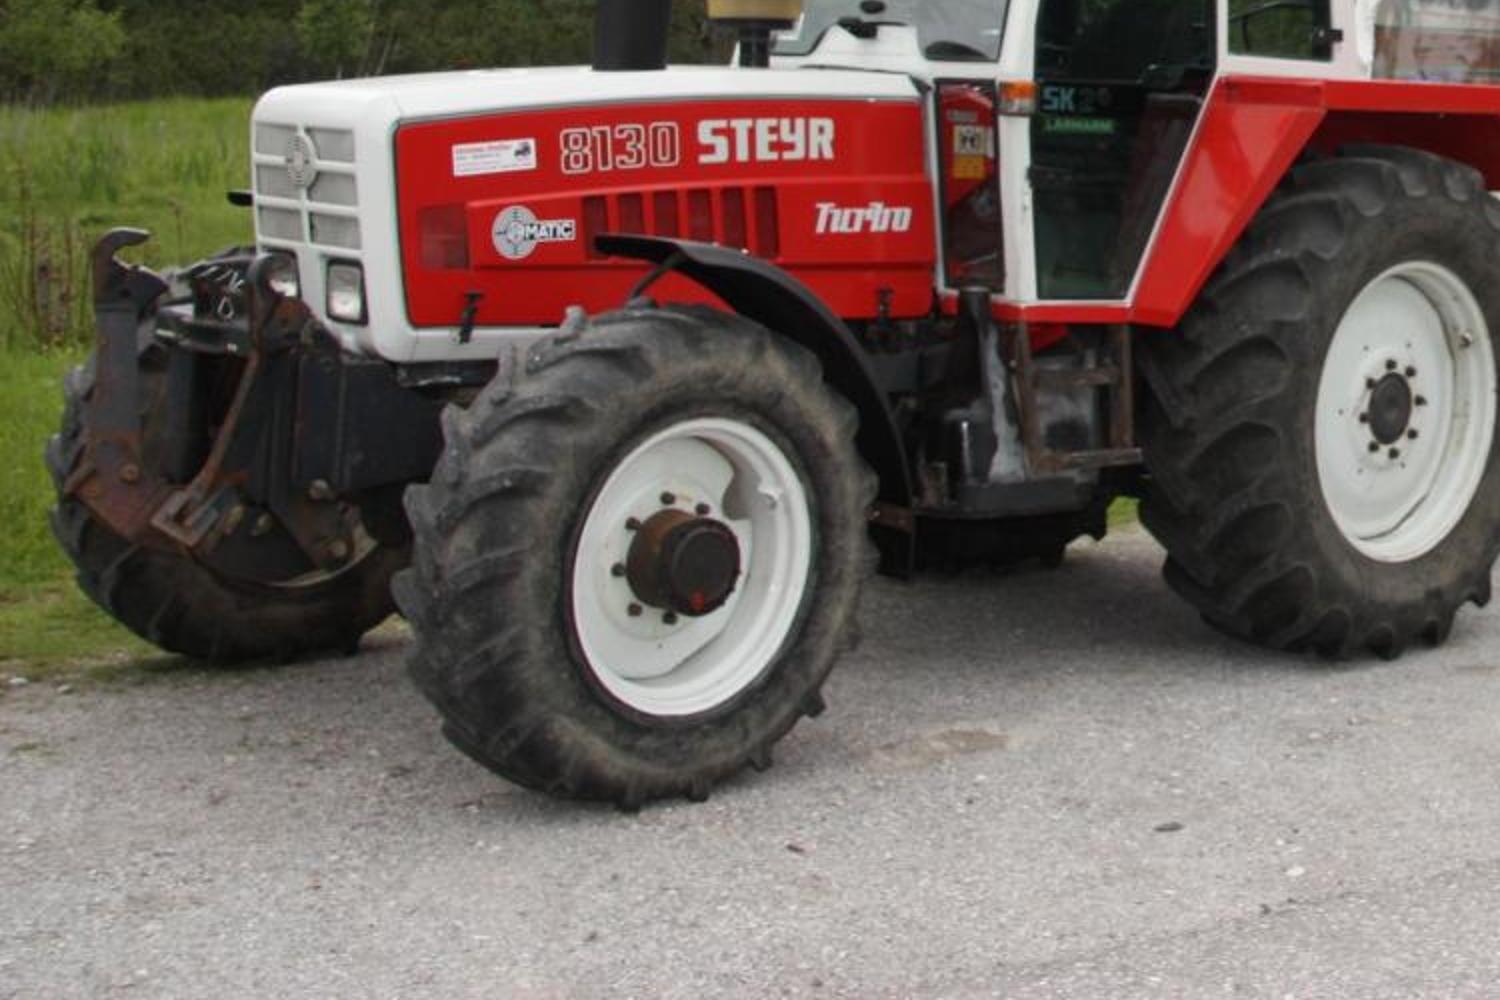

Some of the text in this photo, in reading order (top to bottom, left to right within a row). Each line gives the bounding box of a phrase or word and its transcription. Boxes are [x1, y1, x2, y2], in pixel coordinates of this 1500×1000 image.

[560, 121, 680, 174] 8130
[698, 118, 834, 164] STEYR
[815, 201, 912, 234] Turbo
